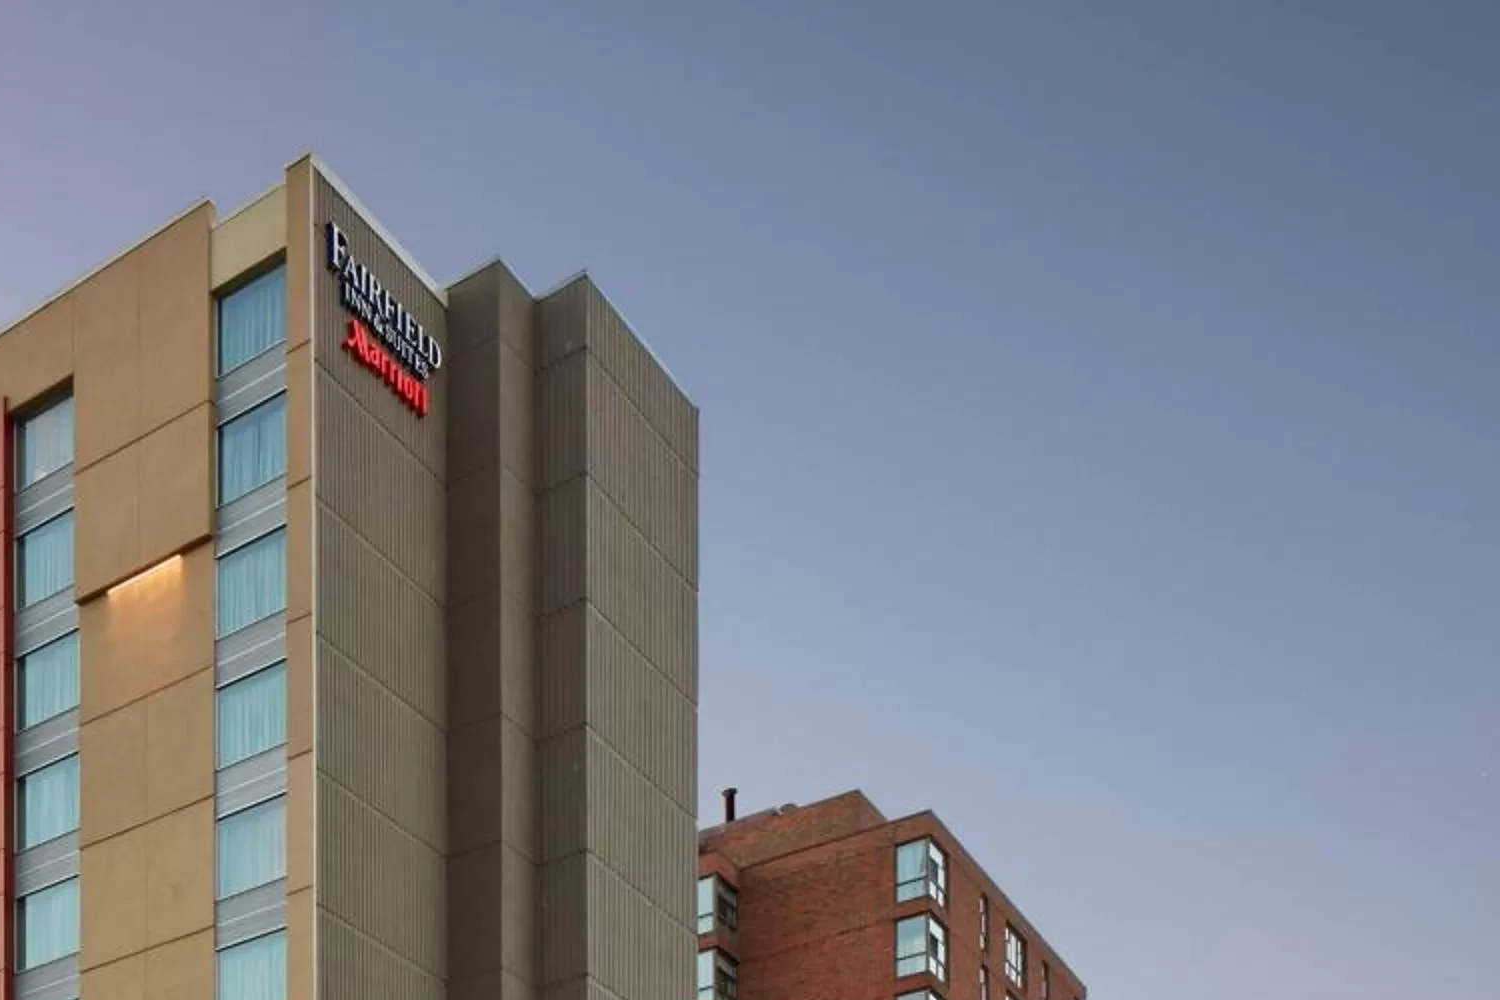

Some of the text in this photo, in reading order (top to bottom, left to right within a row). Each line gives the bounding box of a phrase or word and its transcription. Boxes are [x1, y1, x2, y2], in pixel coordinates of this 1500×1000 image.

[327, 221, 442, 370] FAIRFIELD
[343, 282, 372, 323] INN
[385, 323, 430, 380] SUITES
[342, 319, 429, 417] Marriott
